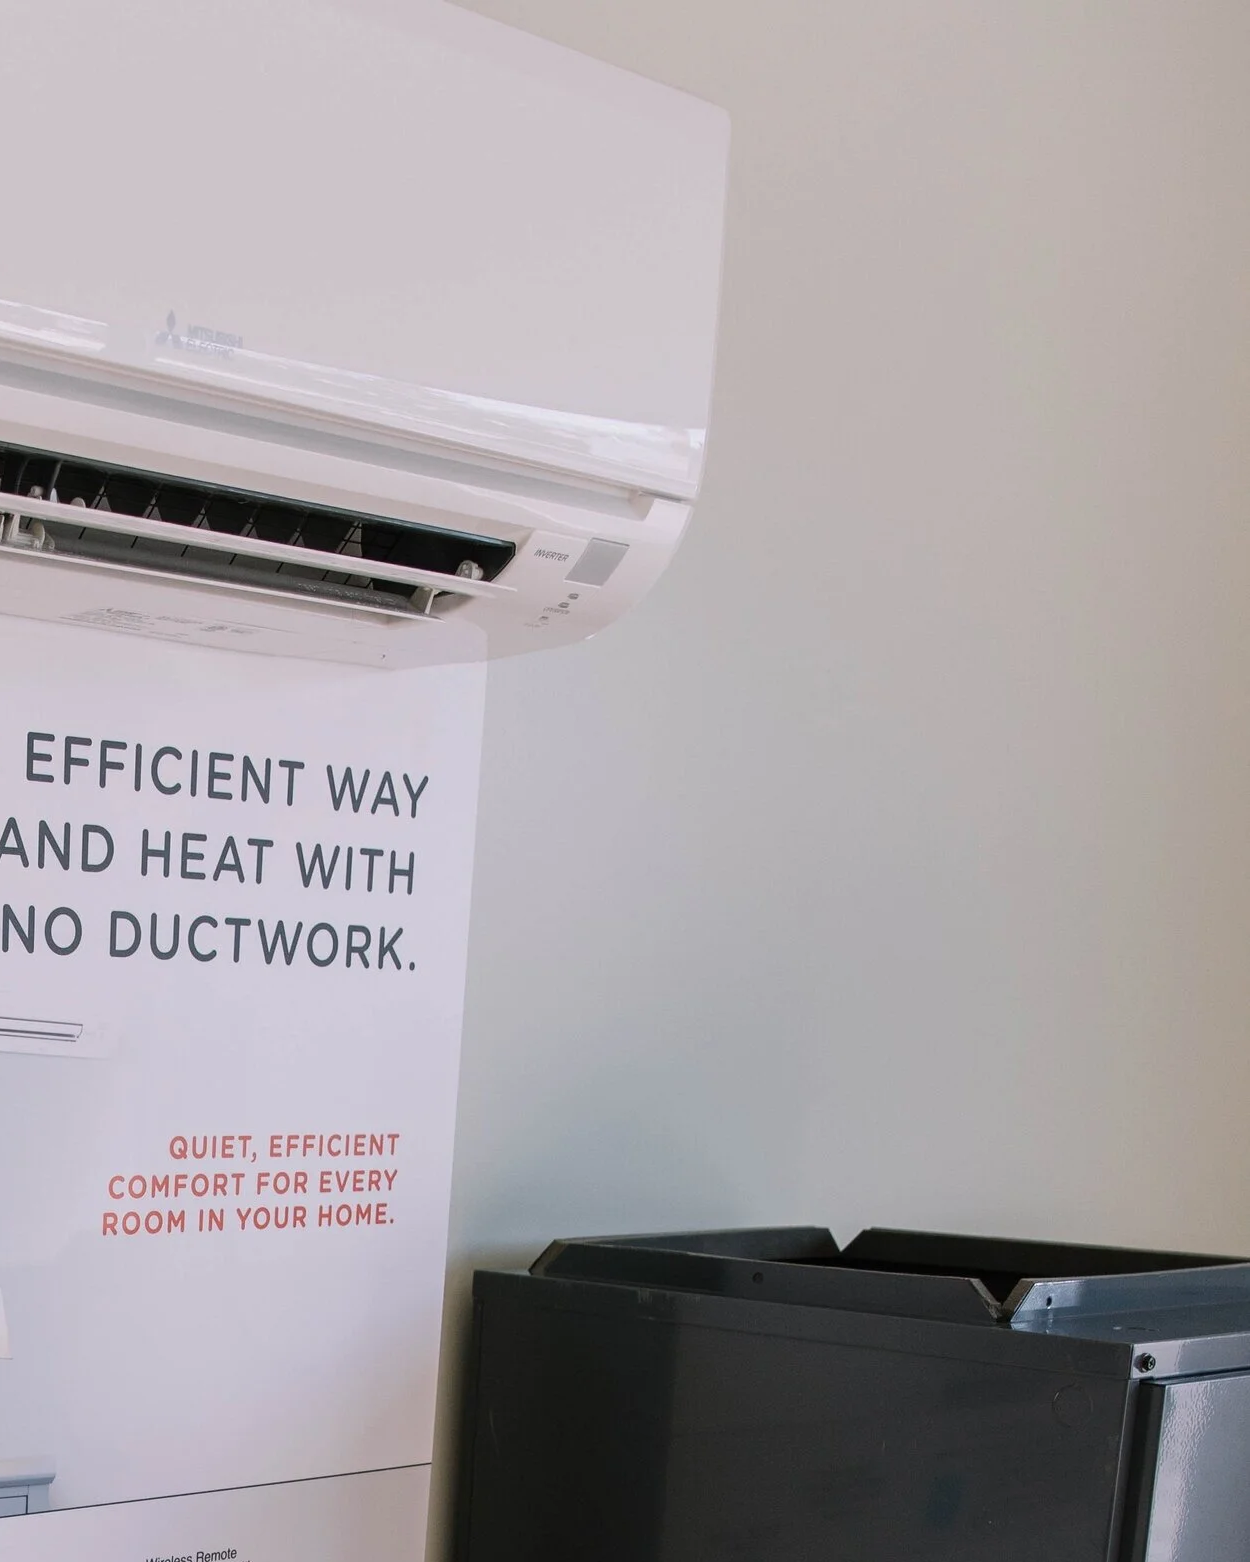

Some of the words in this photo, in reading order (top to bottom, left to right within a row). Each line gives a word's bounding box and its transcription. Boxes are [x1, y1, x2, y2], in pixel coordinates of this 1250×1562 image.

[534, 549, 570, 562] INVERTER
[26, 732, 305, 806] EFFICIENT
[326, 764, 429, 819] WAY
[141, 828, 274, 884] HEAT
[296, 842, 414, 895] WITH
[2, 904, 82, 956] NO
[110, 910, 415, 971] DUCTWORK.
[170, 1136, 256, 1162] QUIET,
[270, 1134, 400, 1157] EFFICIENT
[109, 1173, 245, 1199] COMFORT
[257, 1172, 308, 1195] FOR
[320, 1169, 398, 1193] EVERY
[103, 1210, 185, 1236] ROOM
[199, 1208, 224, 1232] IN
[236, 1206, 306, 1230] YOUR
[318, 1203, 394, 1227] HOME.
